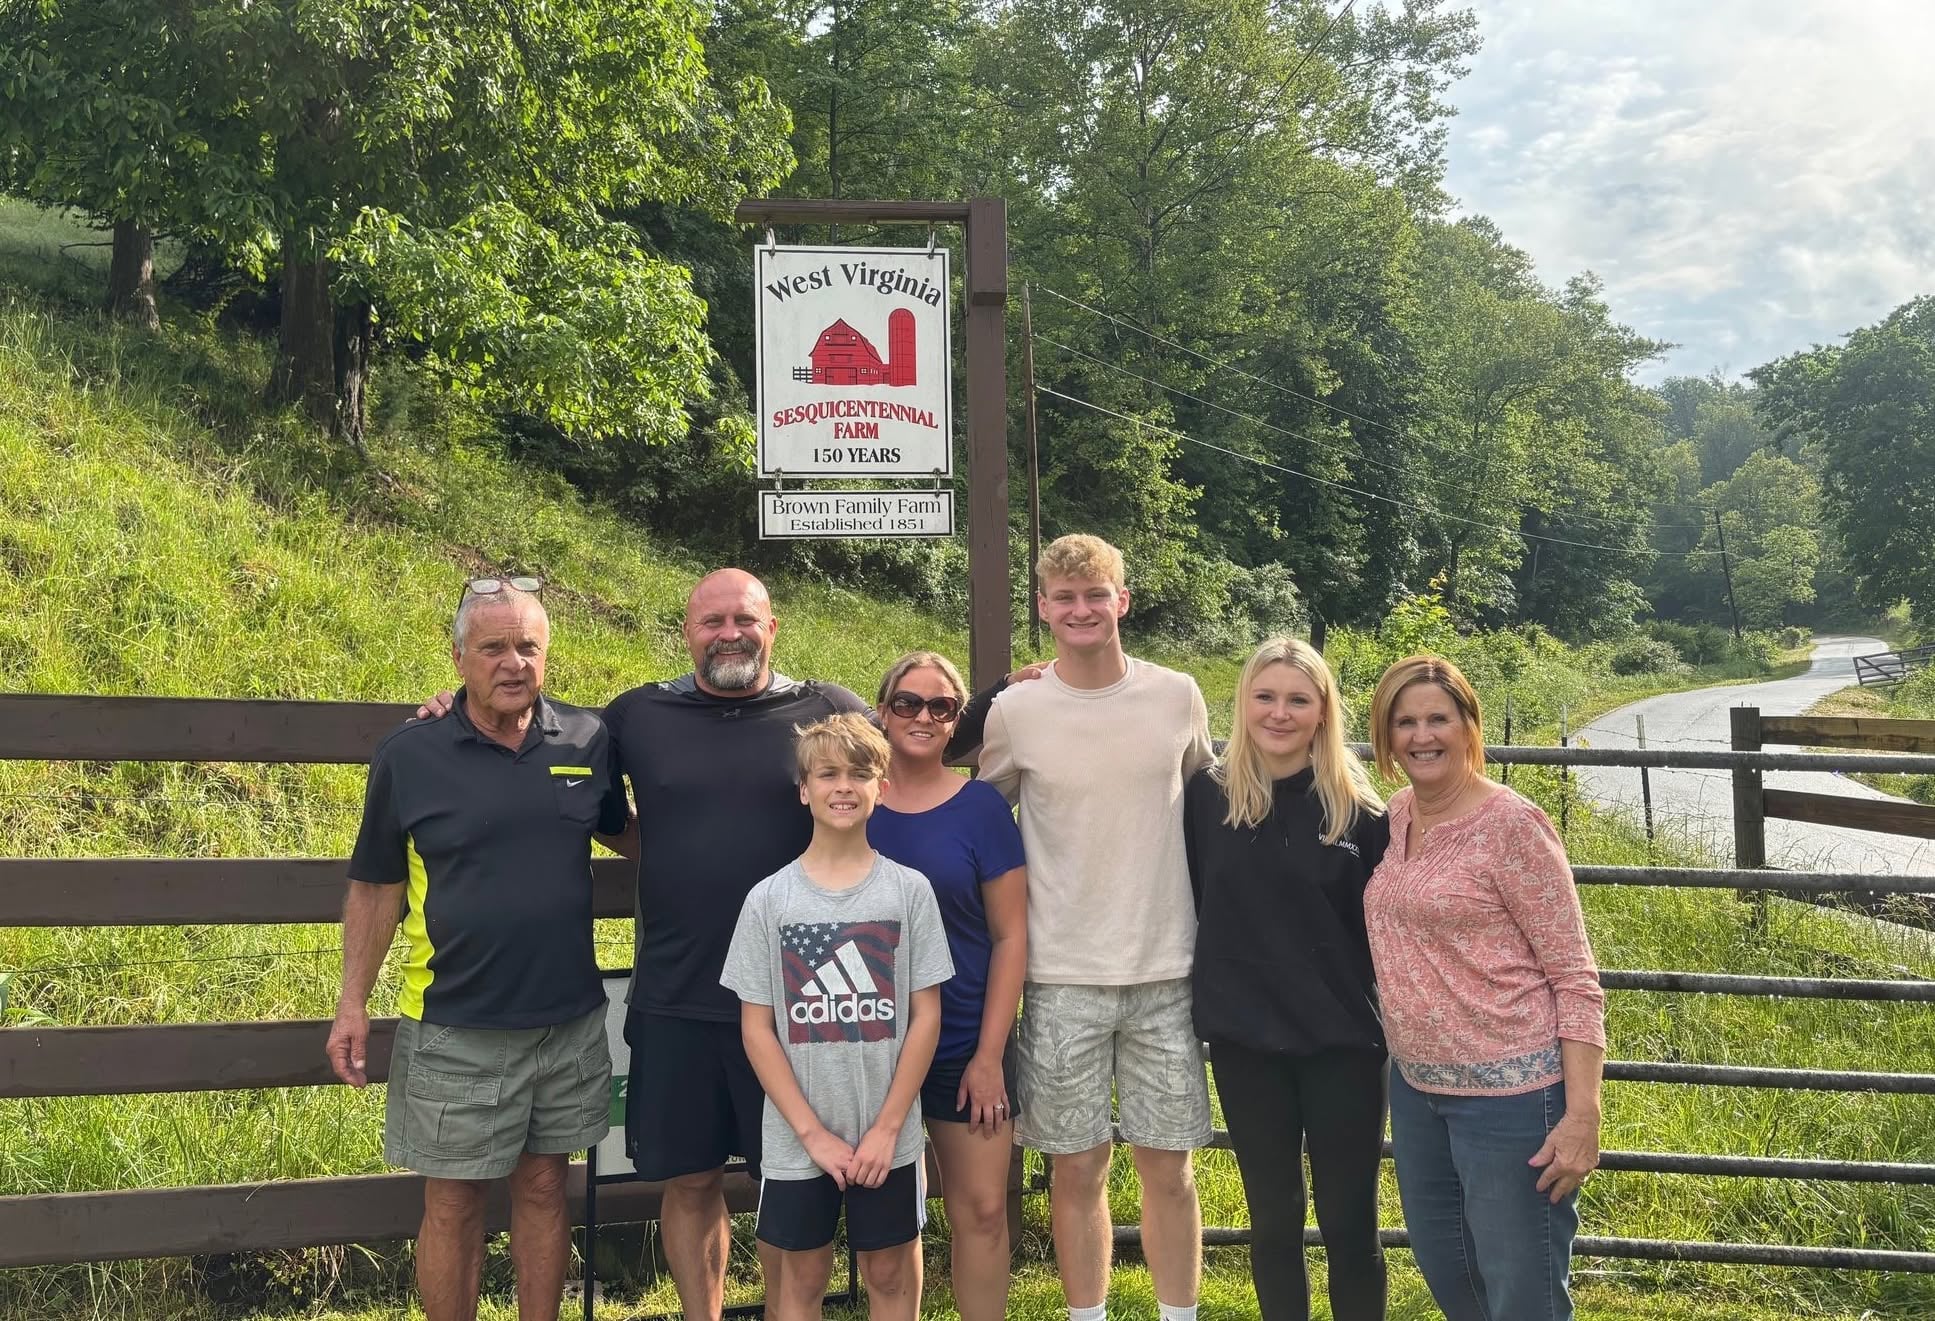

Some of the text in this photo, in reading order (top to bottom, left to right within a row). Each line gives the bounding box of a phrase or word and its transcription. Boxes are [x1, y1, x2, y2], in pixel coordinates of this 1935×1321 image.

[765, 261, 942, 307] West Virginia
[773, 400, 939, 429] SESQUICENTENNIAL
[834, 422, 880, 440] FARM
[813, 448, 901, 463] 150 YEARS
[772, 498, 942, 518] Brown Family Farm
[791, 518, 925, 531] Established 1851
[790, 992, 895, 1024] adidas
